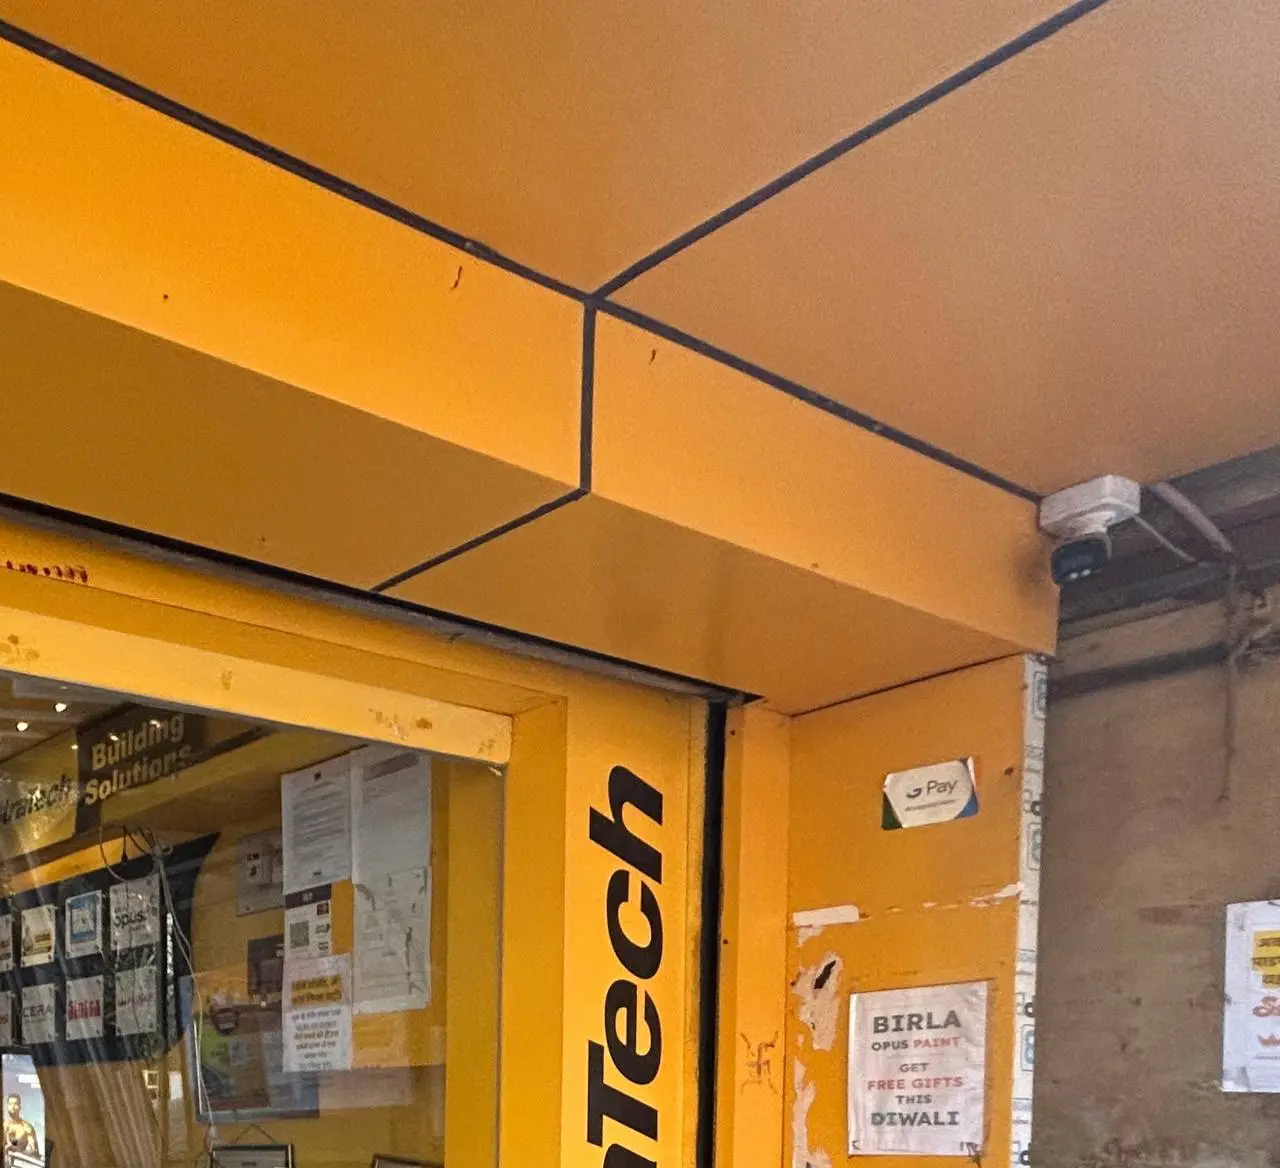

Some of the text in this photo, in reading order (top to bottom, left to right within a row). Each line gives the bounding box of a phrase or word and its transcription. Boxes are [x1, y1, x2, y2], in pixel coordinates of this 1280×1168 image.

[91, 713, 184, 771] Building
[84, 743, 193, 805] Solutions
[926, 780, 957, 796] Pay
[873, 1010, 961, 1033] BIRLA
[871, 1036, 961, 1051] OPUS PAINT
[899, 1062, 929, 1073] GET
[868, 1076, 964, 1091] FREE GIFTS
[895, 1095, 933, 1105] THIS
[870, 1111, 960, 1127] DIWALI
